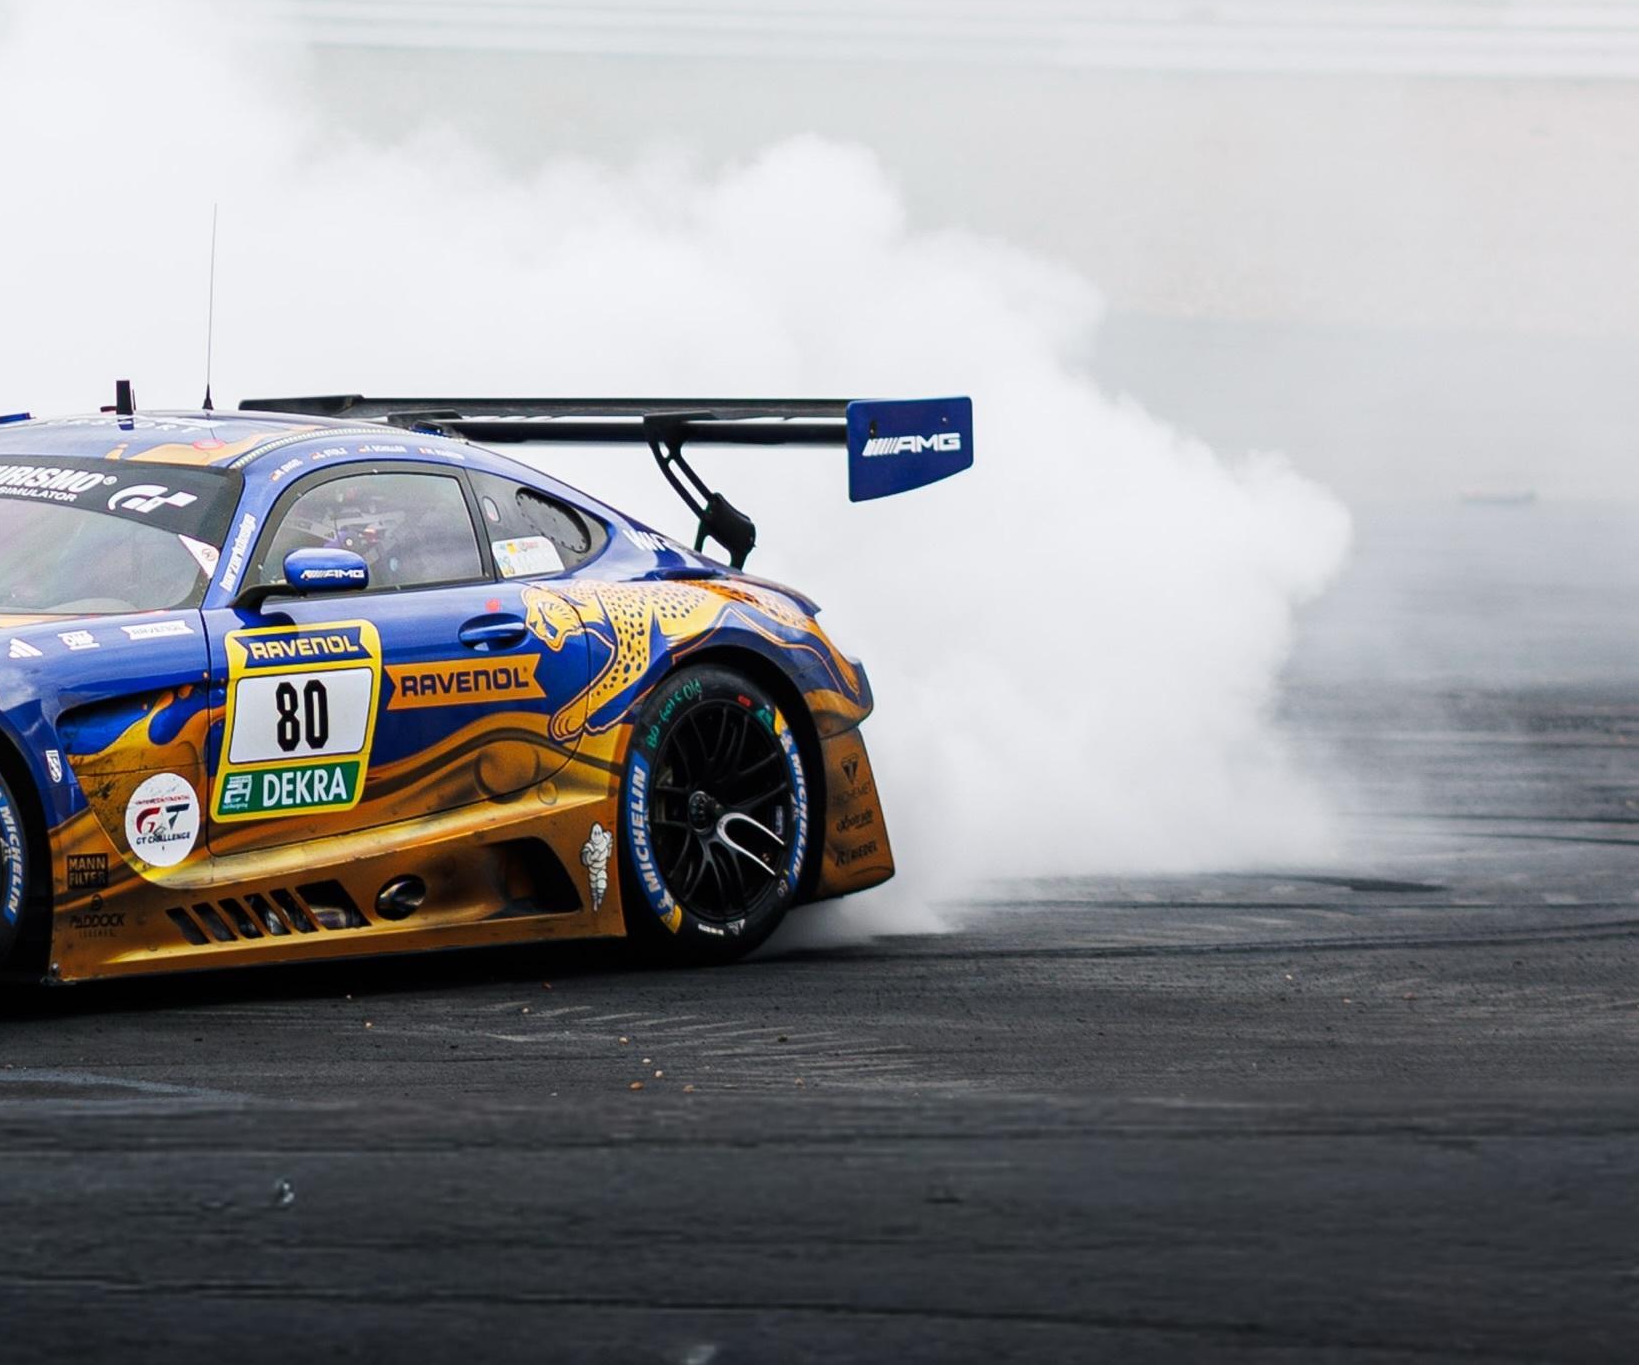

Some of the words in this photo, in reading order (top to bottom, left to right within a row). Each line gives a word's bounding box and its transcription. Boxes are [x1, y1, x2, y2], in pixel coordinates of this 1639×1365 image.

[895, 432, 962, 453] AMG
[248, 633, 359, 661] RAVENOL
[401, 666, 529, 697] RAVENOL
[275, 679, 328, 752] 80
[262, 766, 348, 807] DEKRA
[630, 765, 662, 894] MICHELIN
[790, 752, 809, 879] MICHELIN
[68, 856, 106, 870] MANN
[68, 871, 106, 887] FILTER
